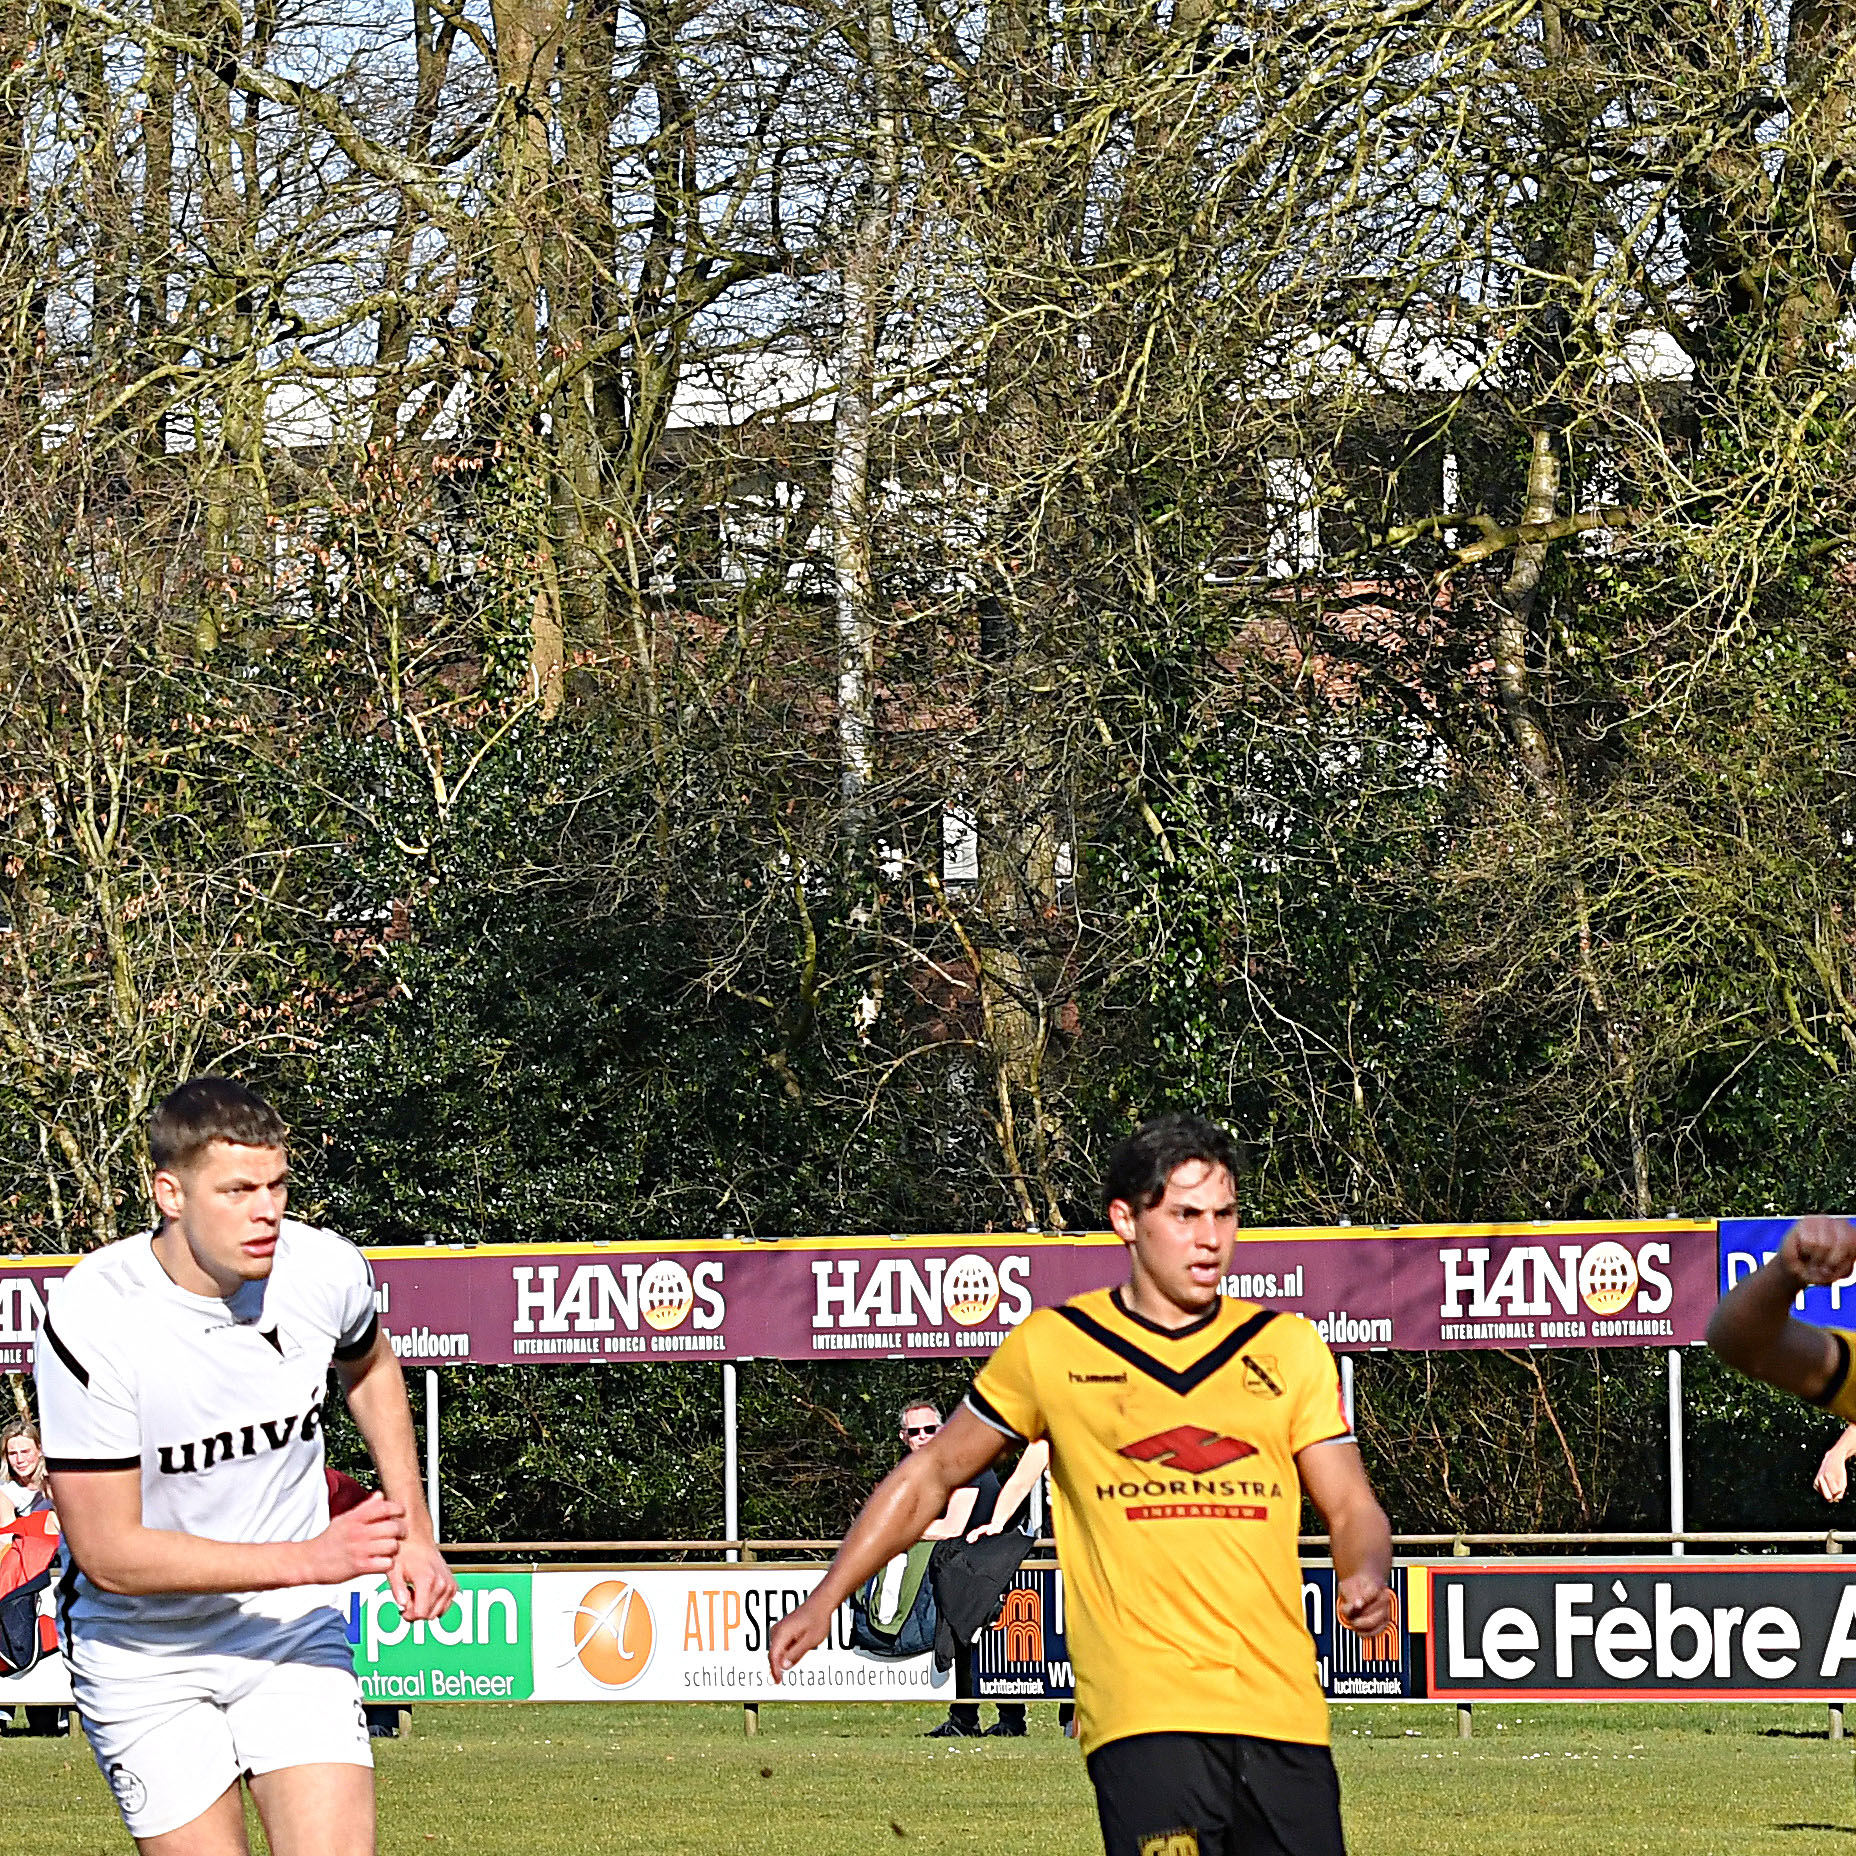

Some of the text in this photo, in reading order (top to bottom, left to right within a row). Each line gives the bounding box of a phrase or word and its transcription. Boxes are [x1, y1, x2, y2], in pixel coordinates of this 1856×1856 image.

[811, 1254, 1032, 1328] HANOS
[1439, 1241, 1674, 1318] HANOS
[513, 1259, 726, 1333] HANOS
[812, 1333, 902, 1351] INTERNATIONALE
[907, 1332, 950, 1349] HORECA
[1441, 1319, 1674, 1340] INTERNATIONALE HORECA GROOTHANDEL
[513, 1334, 726, 1355] INTERNATIONALE HORECA GROOTHANDEL
[1096, 1477, 1284, 1501] HOORNSTRA
[1446, 1582, 1540, 1680] Le
[1554, 1579, 1801, 1680] Fèbre
[358, 1669, 514, 1697] ntraal Beheer
